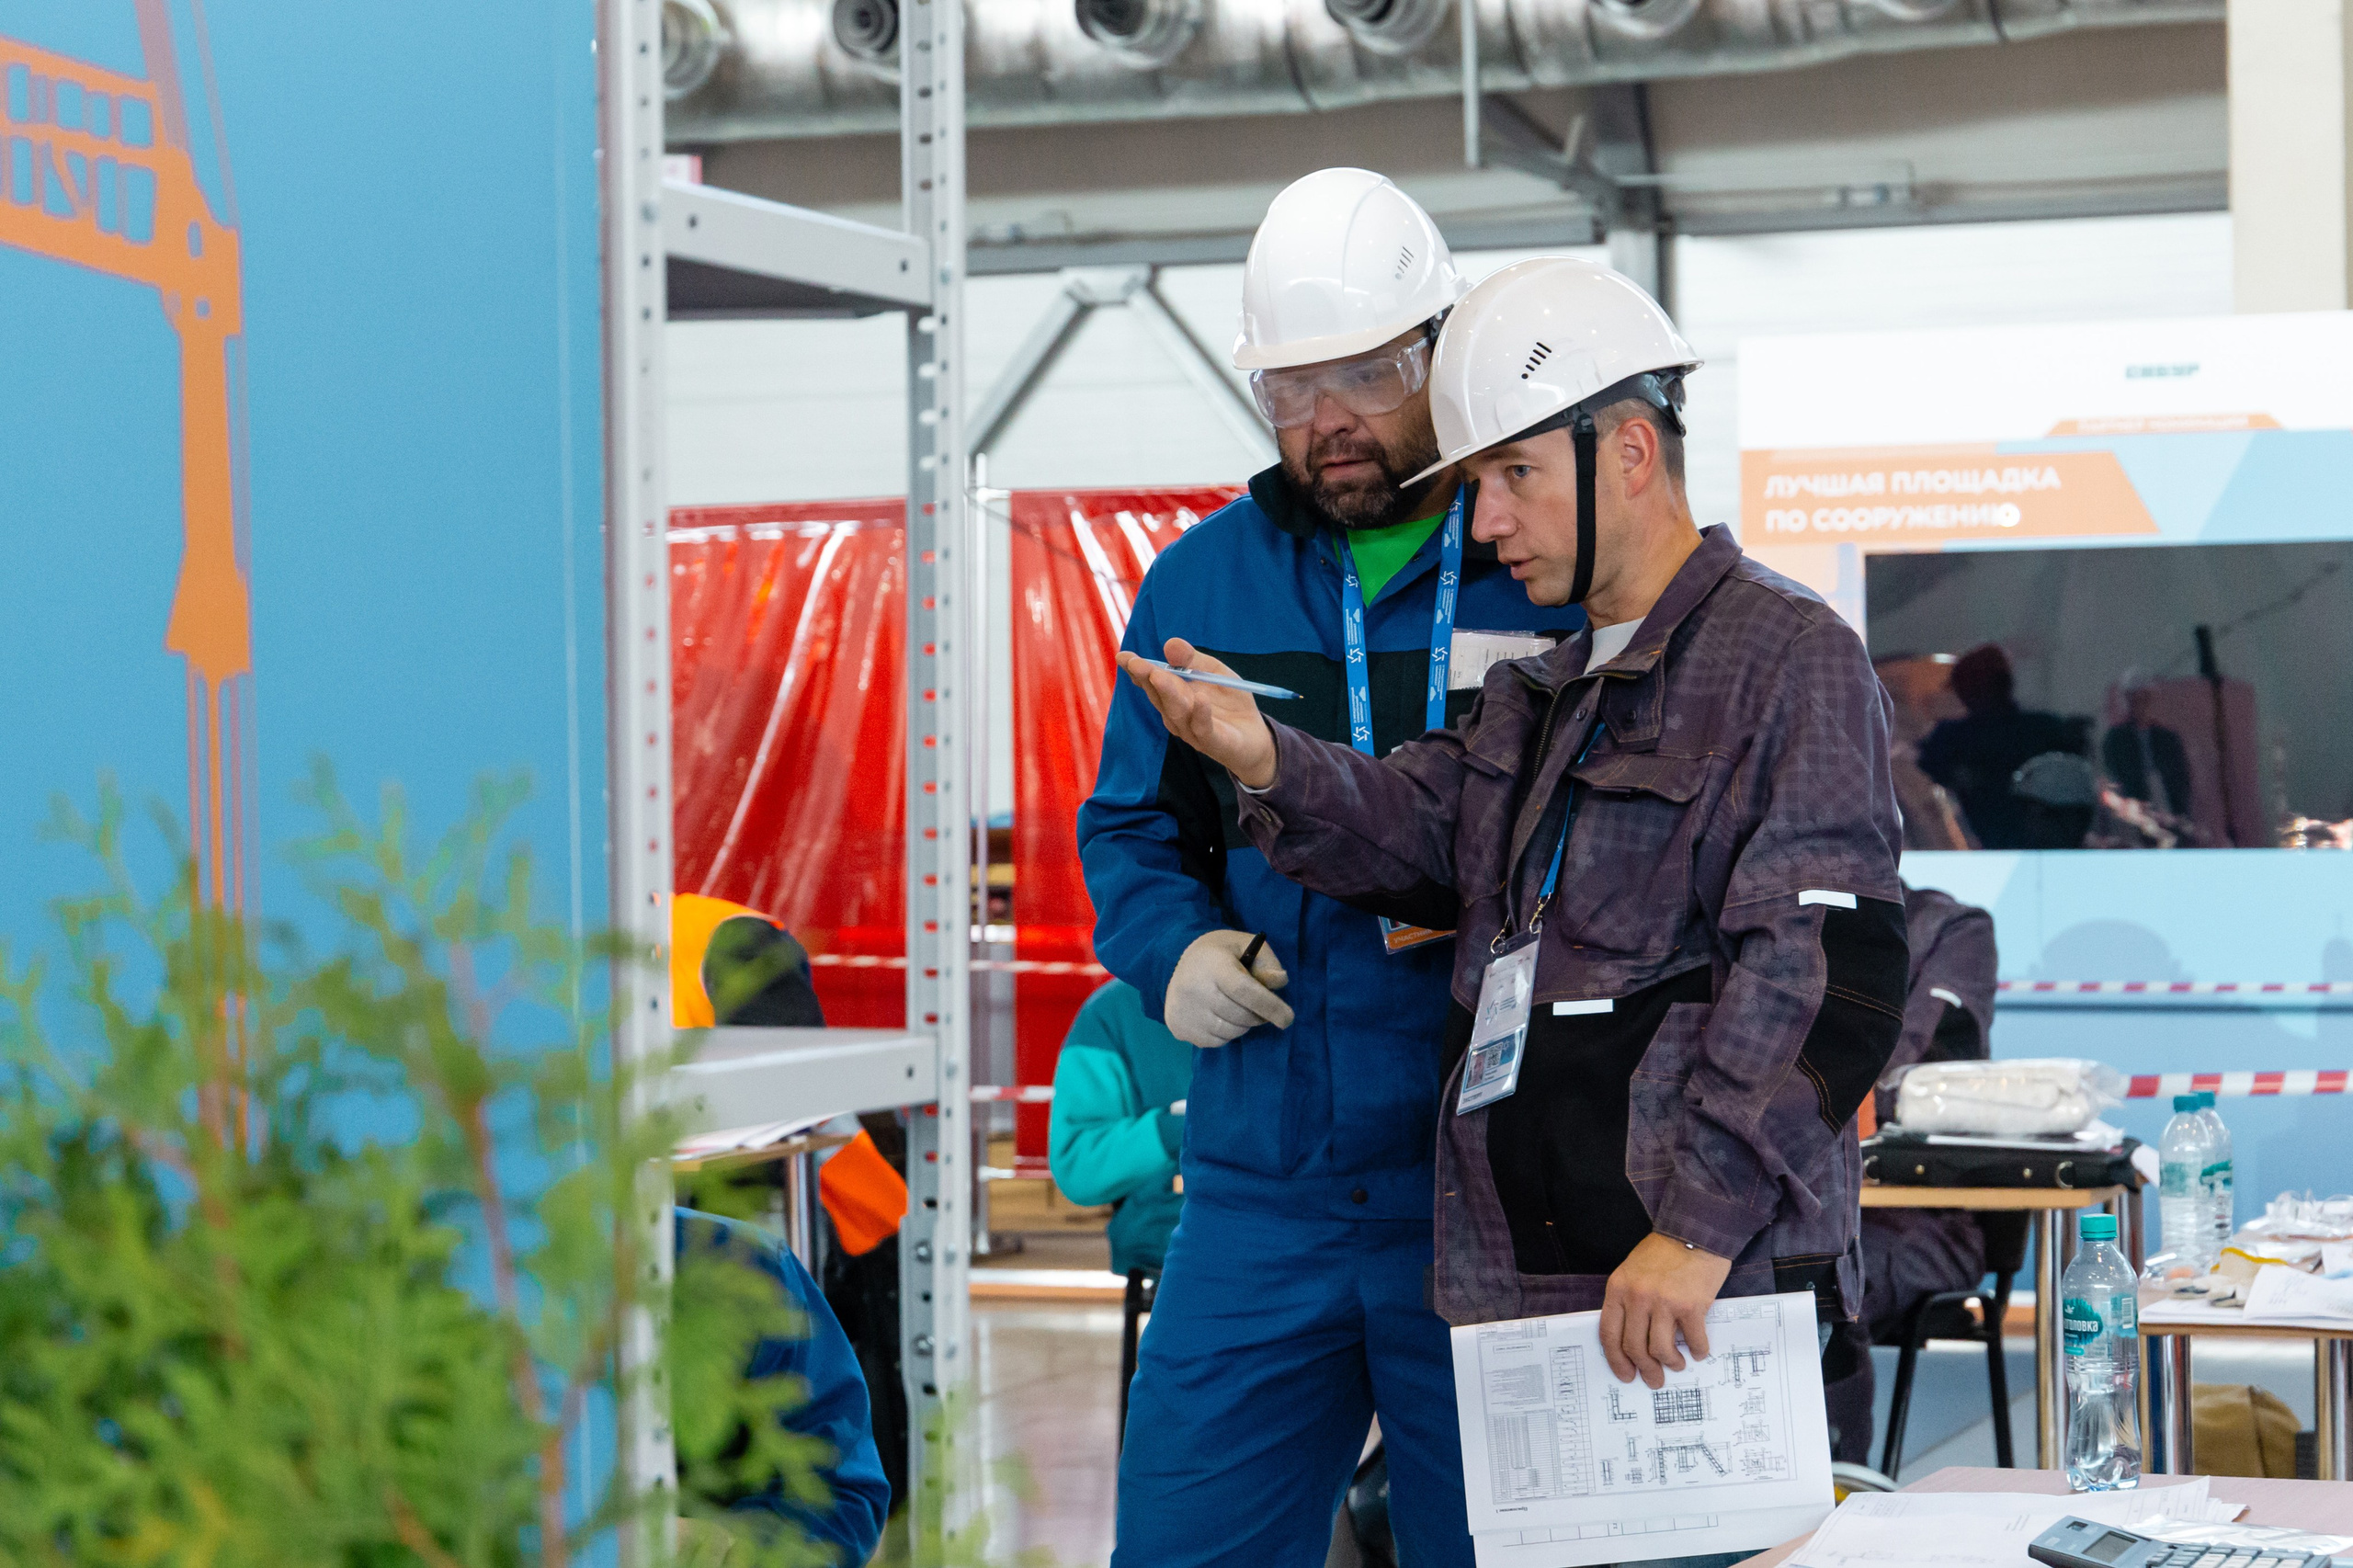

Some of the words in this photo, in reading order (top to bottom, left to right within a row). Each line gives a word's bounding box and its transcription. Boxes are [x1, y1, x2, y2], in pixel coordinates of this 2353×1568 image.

[1764, 472, 1885, 499] ЛУЧШАЯ
[1891, 466, 2062, 494] ПЛОЩАДКА
[1765, 509, 1808, 532] ПО
